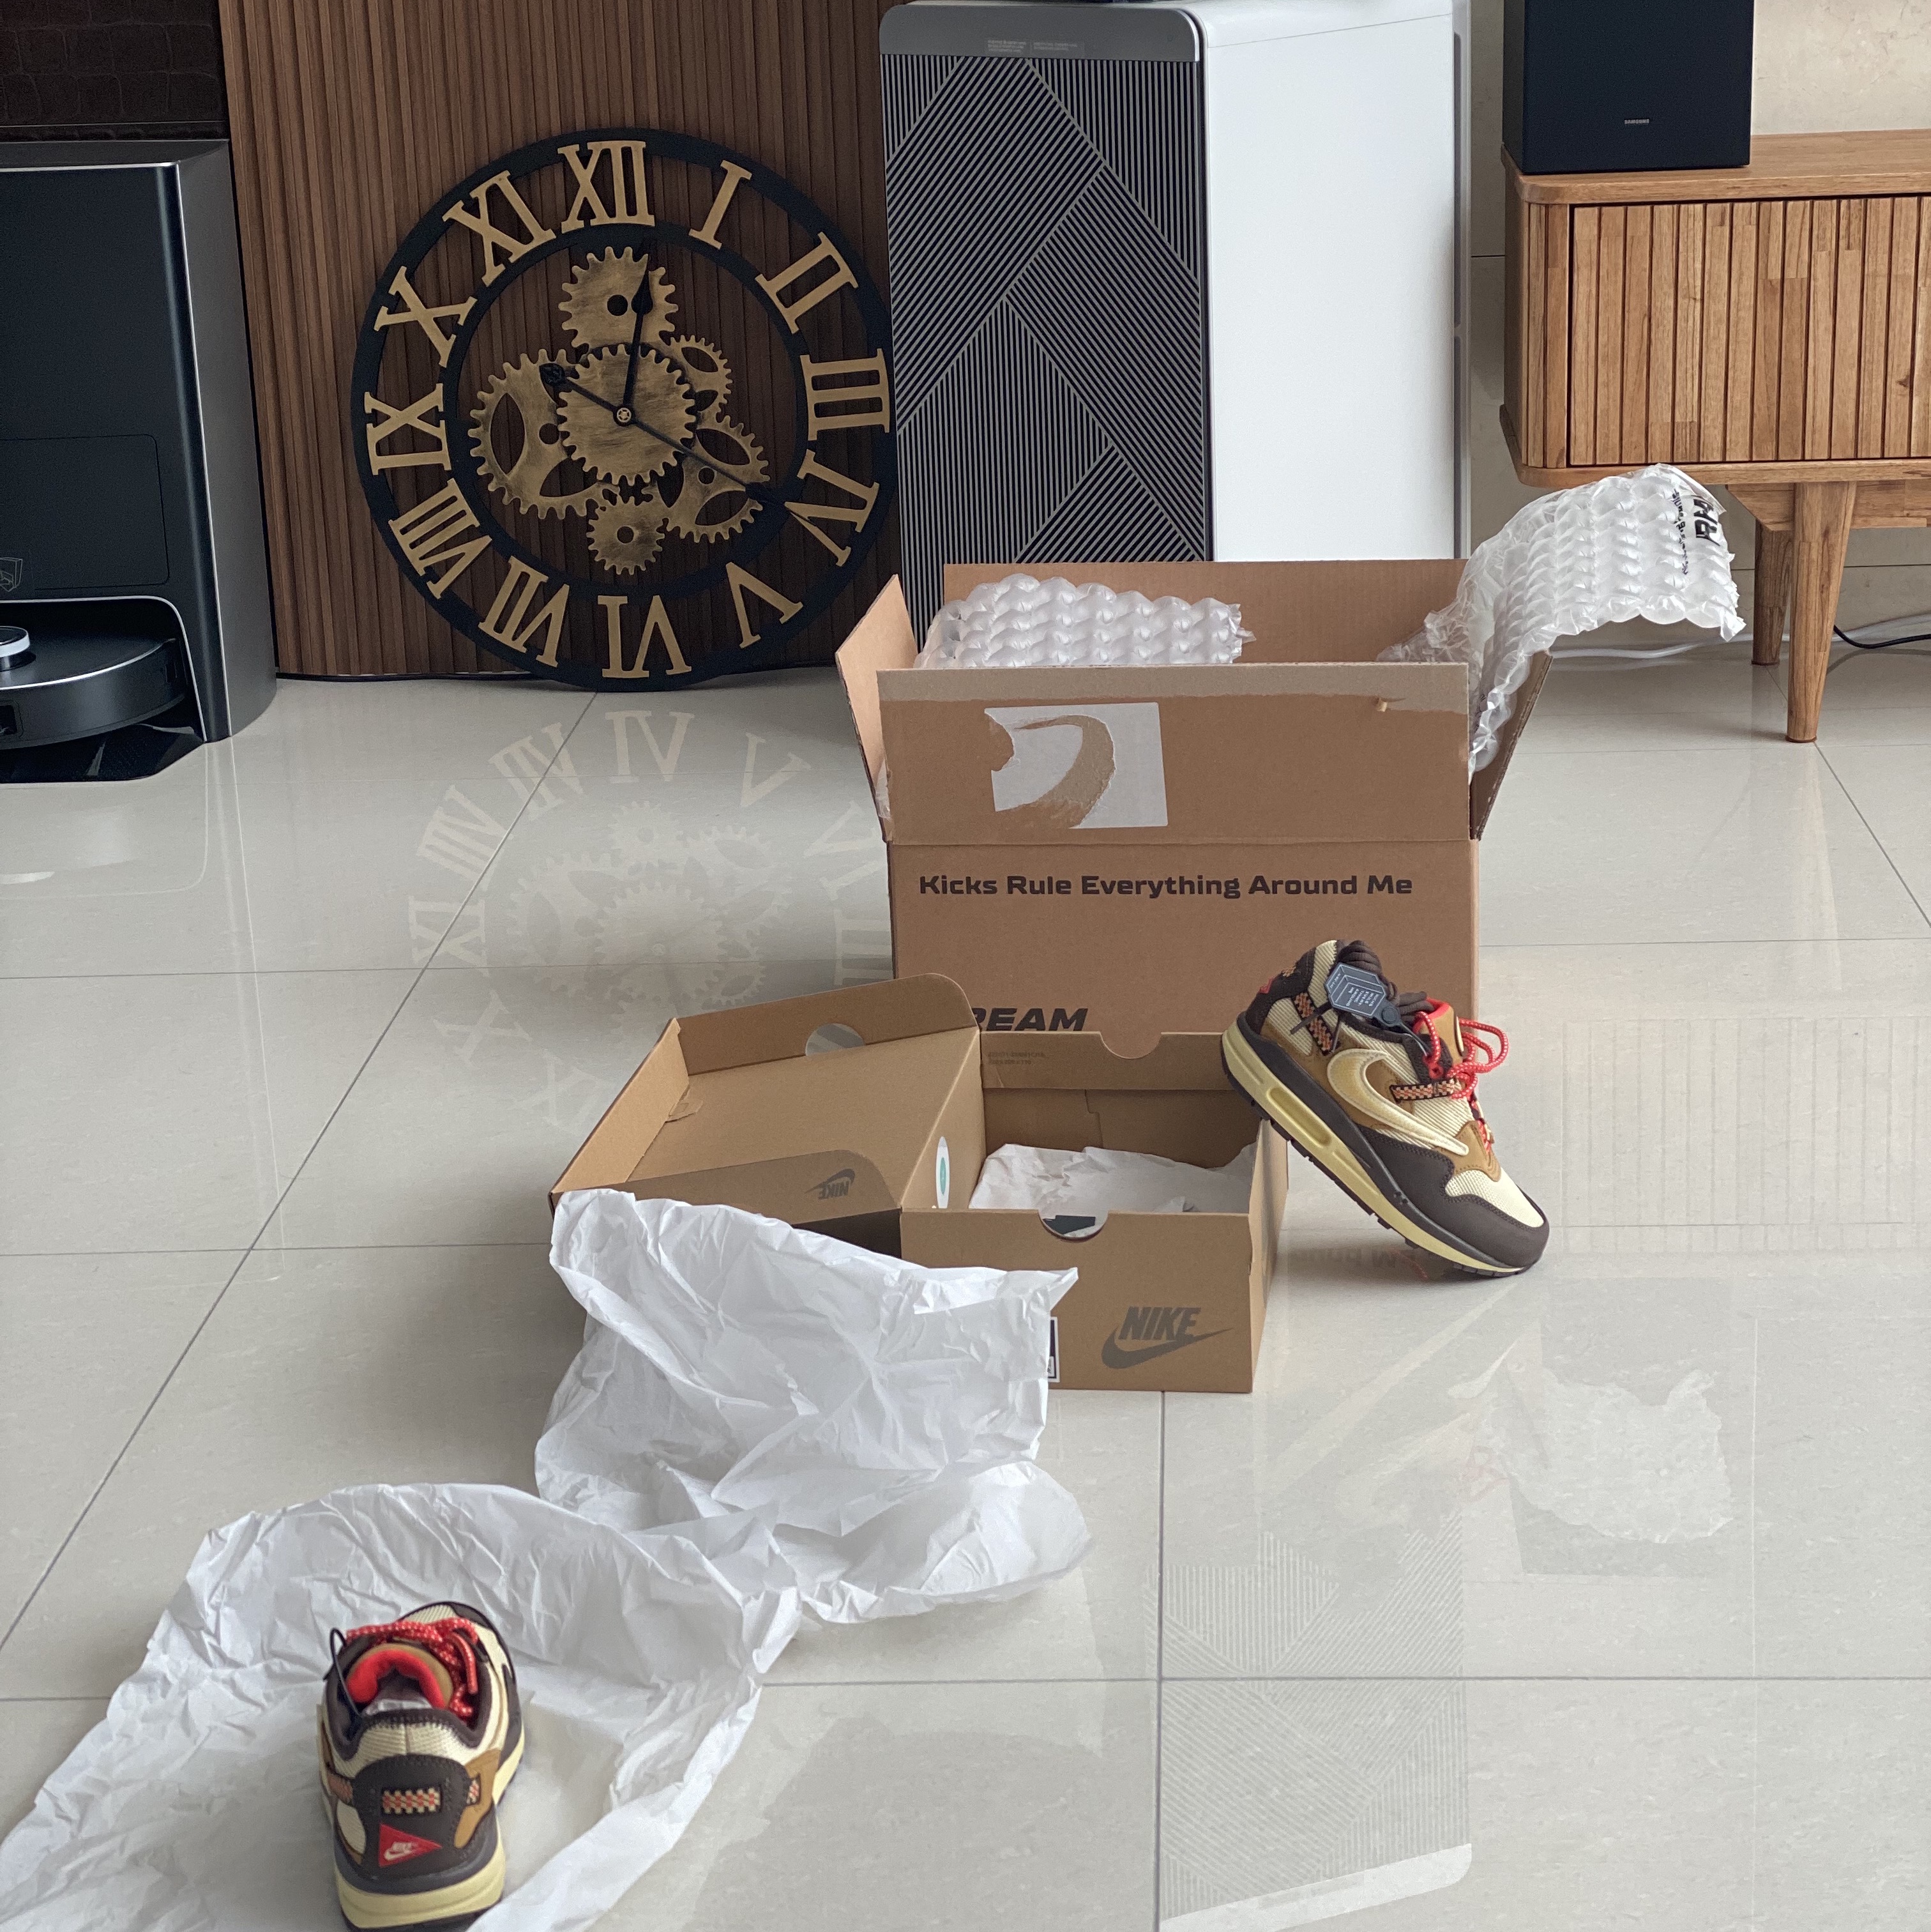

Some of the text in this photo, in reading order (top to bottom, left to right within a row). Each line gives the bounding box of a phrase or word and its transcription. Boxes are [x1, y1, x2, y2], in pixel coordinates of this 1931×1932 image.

[442, 170, 556, 287] XI
[557, 140, 655, 231] XII
[689, 160, 752, 249] I
[374, 266, 477, 368] X
[755, 232, 858, 334] II
[364, 383, 451, 475] IX
[800, 348, 891, 441] III
[388, 478, 492, 600] VIII
[784, 450, 880, 567] IV
[478, 556, 570, 668] VII
[598, 595, 692, 678] VI
[725, 562, 803, 649] V
[920, 874, 1412, 899] Kicks Rule Everything Around Me
[1117, 1306, 1202, 1342] NIKE
